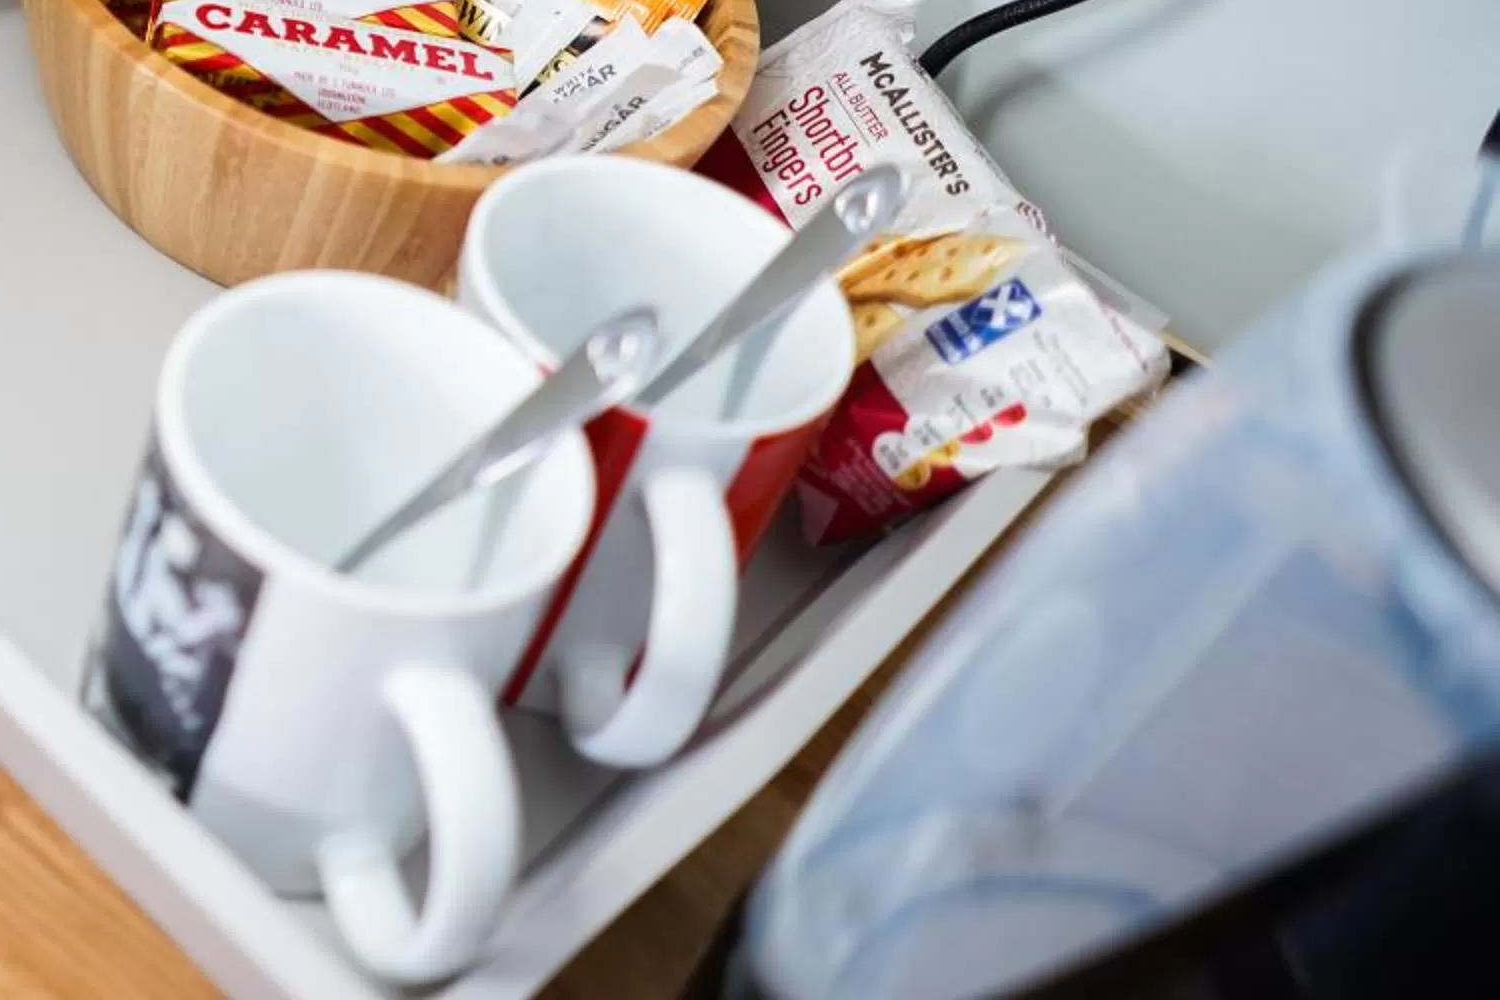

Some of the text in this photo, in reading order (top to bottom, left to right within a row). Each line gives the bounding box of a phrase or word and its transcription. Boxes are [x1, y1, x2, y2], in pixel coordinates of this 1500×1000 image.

[196, 3, 494, 81] CARAMEL
[752, 108, 823, 206] Fingers
[788, 85, 864, 183] Shortbr
[849, 92, 889, 143] BUTTER
